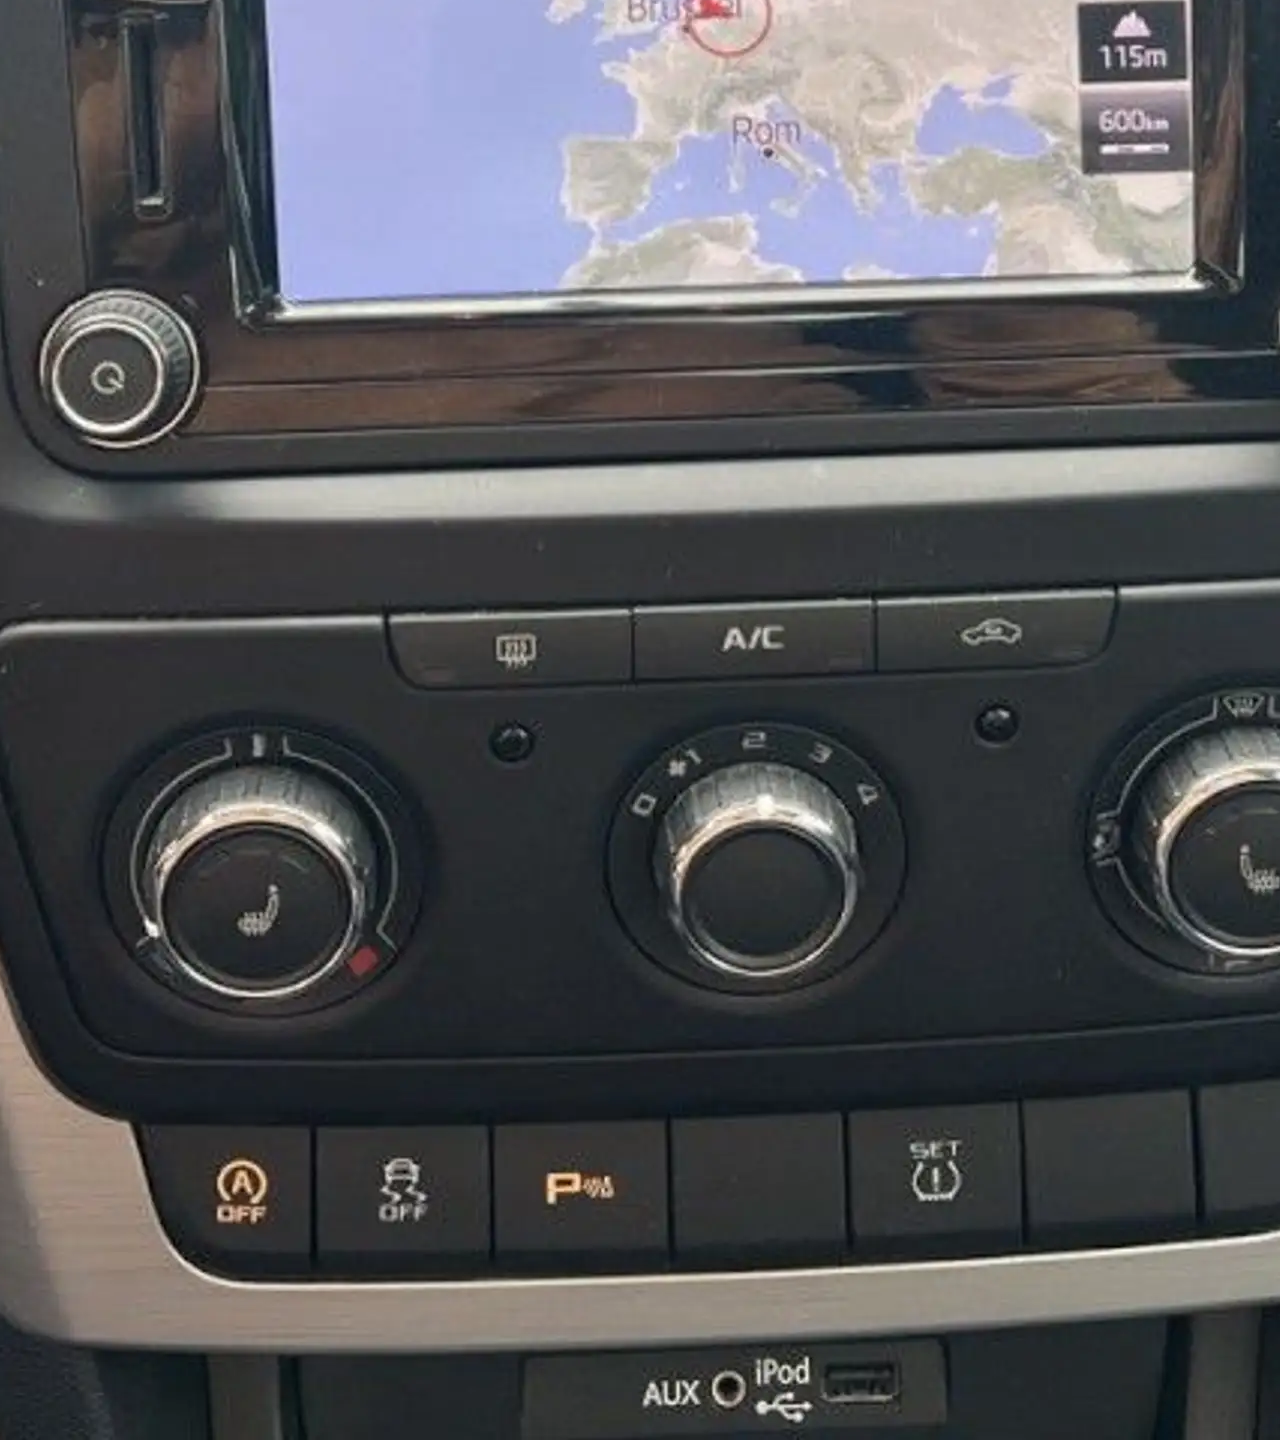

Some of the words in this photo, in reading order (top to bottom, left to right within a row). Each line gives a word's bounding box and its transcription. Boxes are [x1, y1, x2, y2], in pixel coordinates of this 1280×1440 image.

[1099, 44, 1169, 70] 115m
[732, 116, 802, 146] Rom
[722, 624, 786, 652] A/C
[741, 731, 767, 750] 2
[810, 744, 832, 763] 3
[909, 1139, 963, 1160] SET
[216, 1204, 268, 1224] OFF
[378, 1202, 429, 1223] OFF
[755, 1356, 811, 1387] iPod
[642, 1380, 702, 1408] AUX
